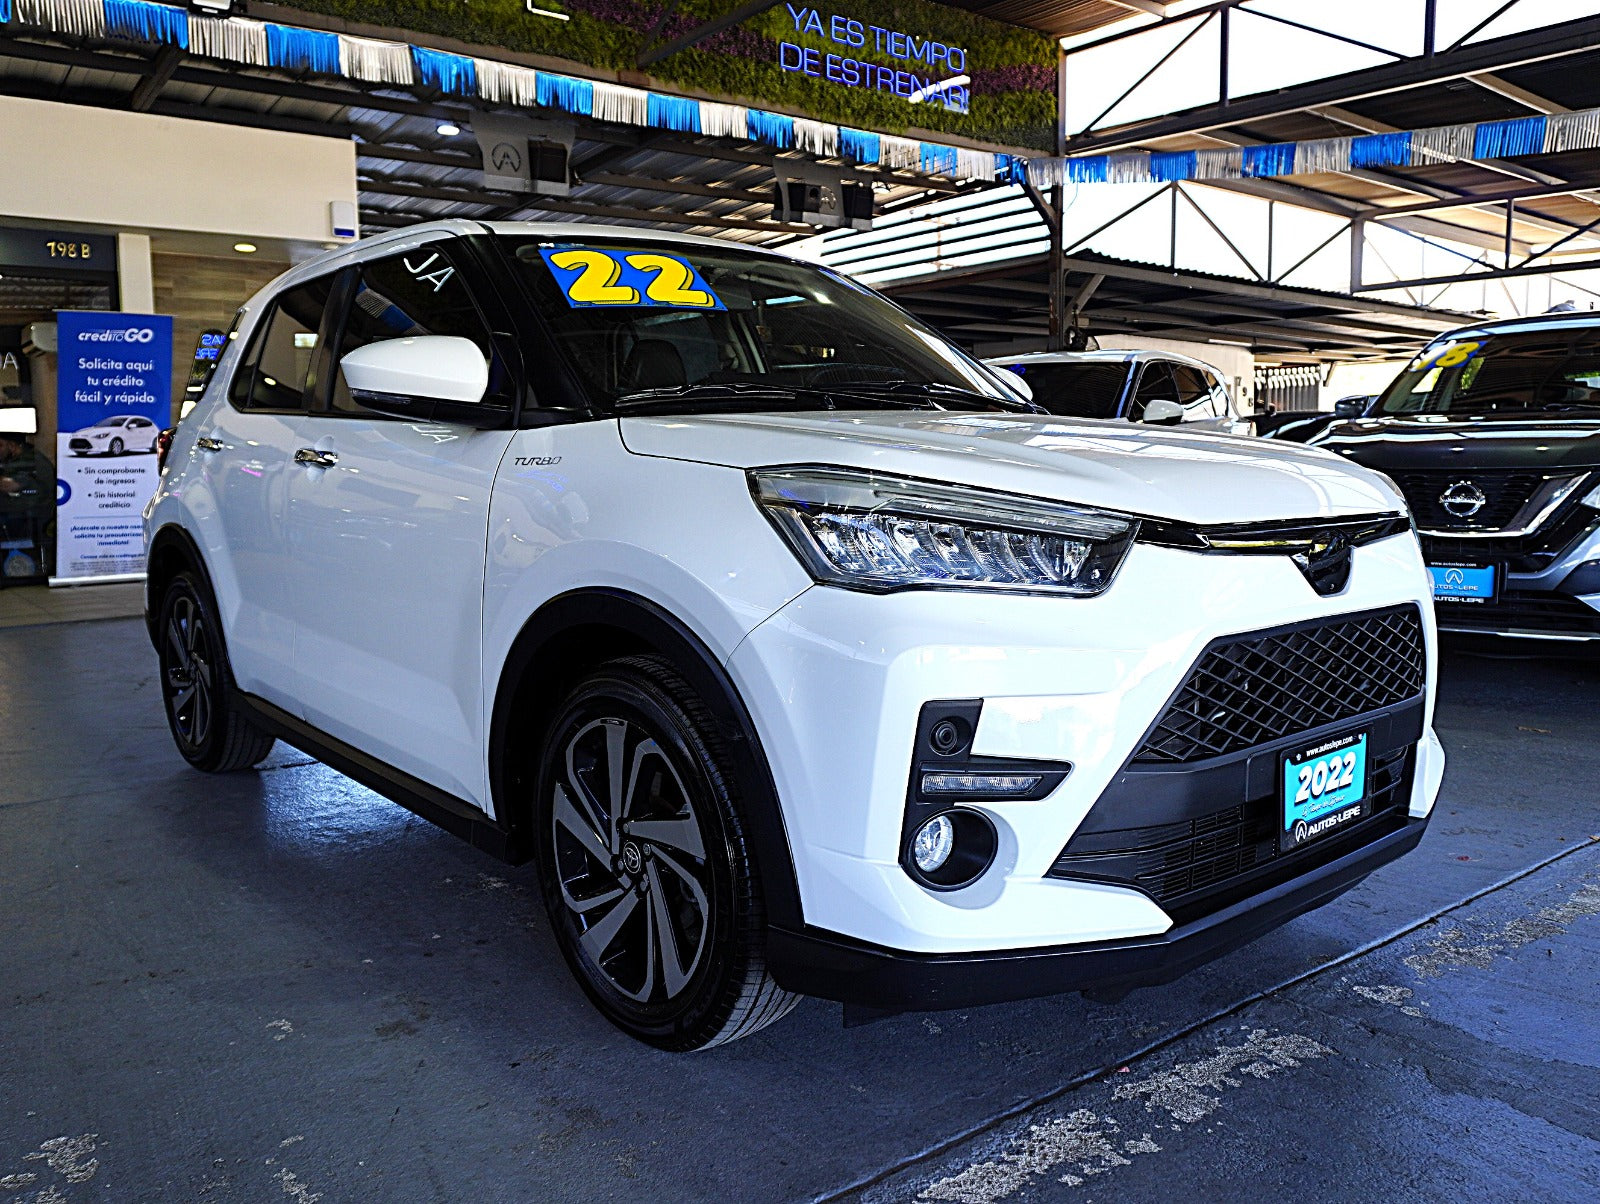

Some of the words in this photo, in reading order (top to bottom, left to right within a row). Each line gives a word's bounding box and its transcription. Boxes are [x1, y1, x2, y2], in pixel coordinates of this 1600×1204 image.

[786, 2, 825, 38] YA
[831, 15, 865, 48] ES
[869, 25, 965, 73] TIEMPO
[780, 41, 821, 77] DE
[46, 242, 77, 258] 798
[81, 243, 91, 258] B
[549, 250, 715, 308] 22
[78, 357, 123, 370] Solicita
[126, 359, 153, 373] aquí
[87, 376, 99, 386] tu
[102, 375, 144, 387] crédito
[75, 390, 101, 402] fácil
[104, 394, 112, 406] y
[115, 391, 155, 406] rápido
[514, 456, 562, 466] TURBO
[84, 466, 95, 475] Sin
[98, 466, 146, 475] comprobante
[94, 477, 104, 485] de
[105, 477, 135, 486] ingresos
[94, 491, 105, 499] Sin
[107, 490, 135, 498] historial
[1293, 751, 1357, 805] 2022
